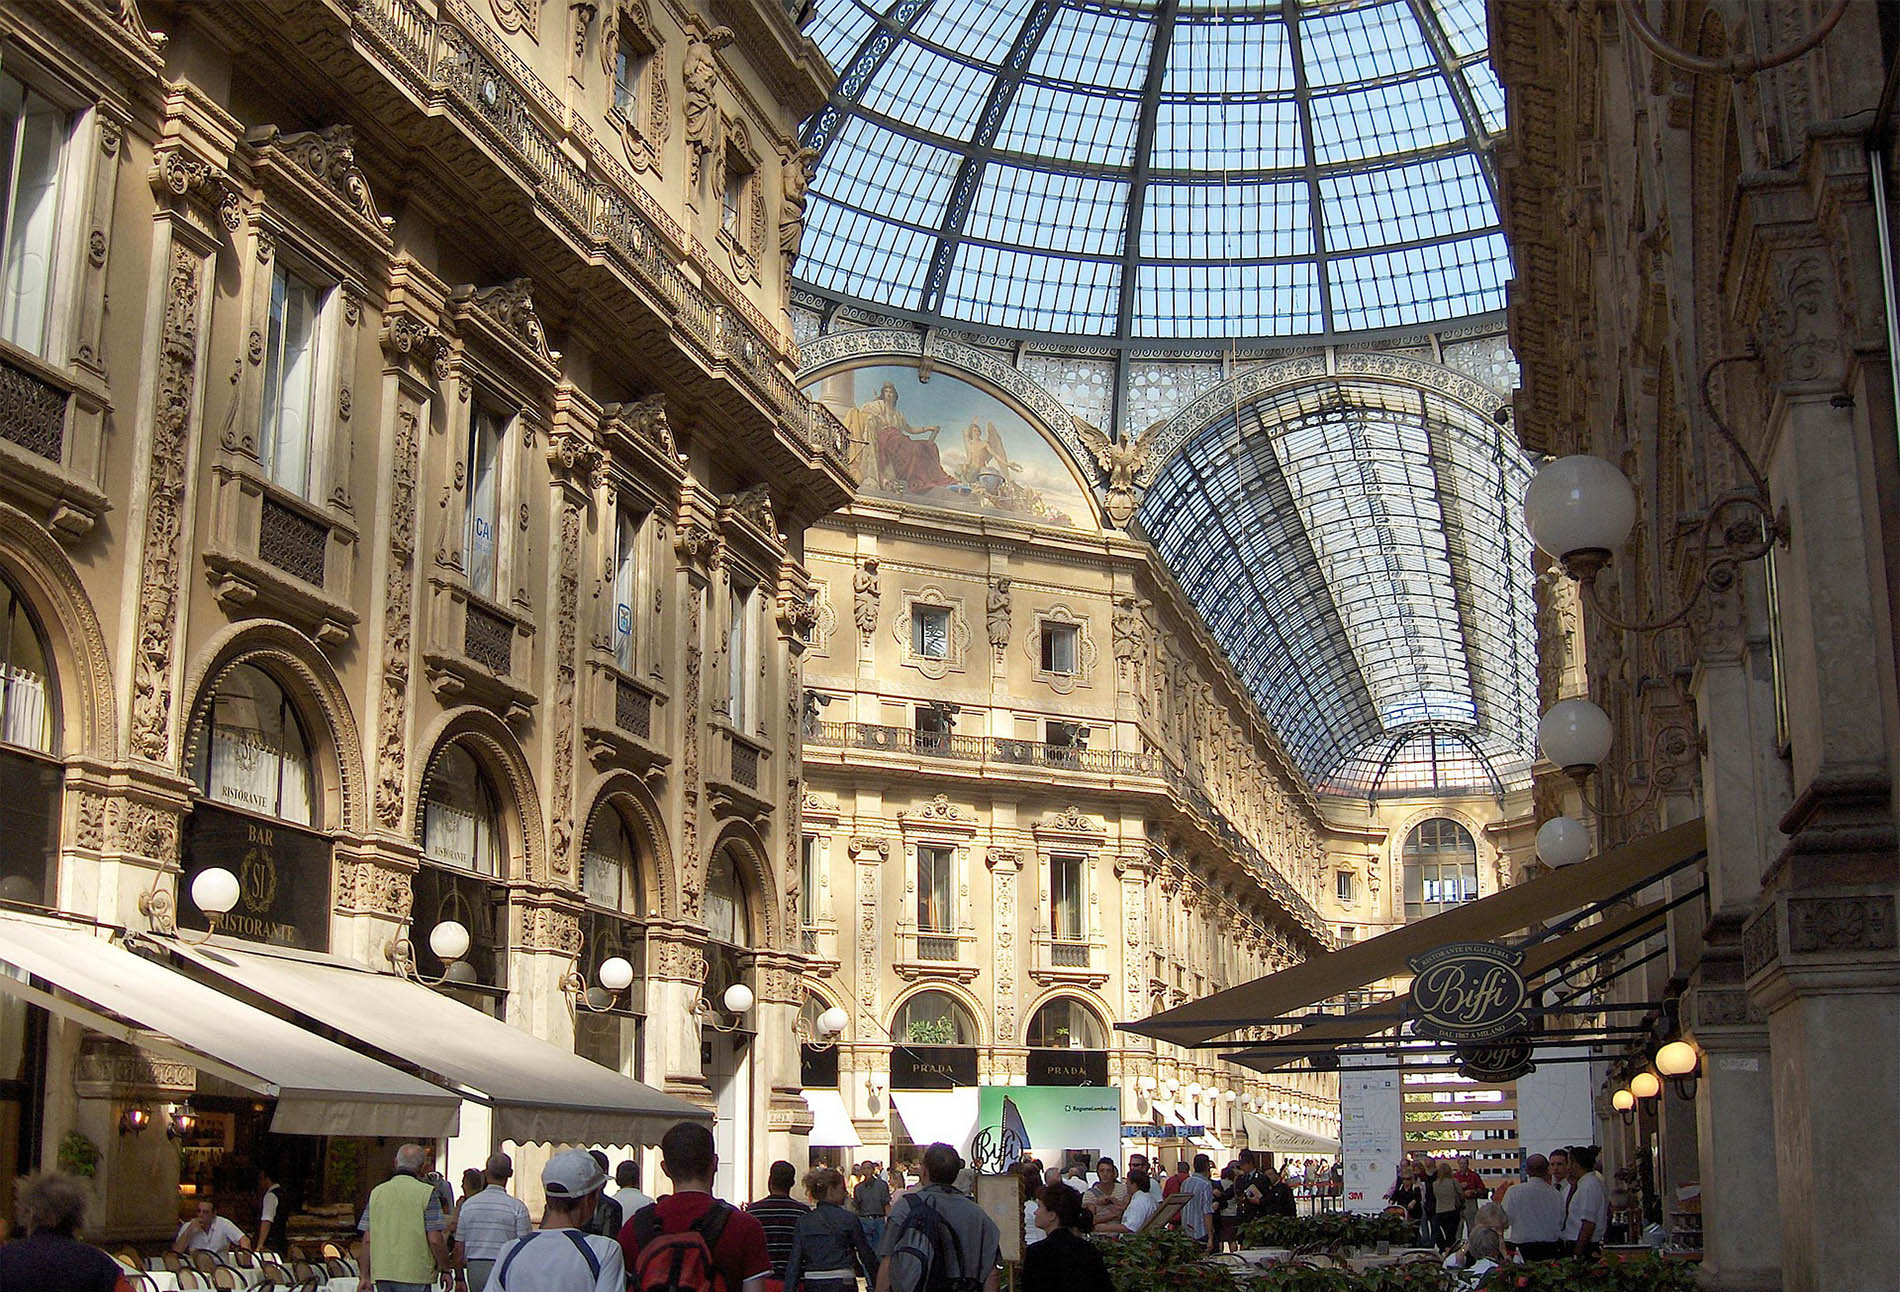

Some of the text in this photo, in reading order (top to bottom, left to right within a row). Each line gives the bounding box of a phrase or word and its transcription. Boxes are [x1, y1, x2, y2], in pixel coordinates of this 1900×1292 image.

[222, 786, 267, 808] RISTORANTE
[248, 824, 273, 846] BAR
[251, 863, 266, 899] SI
[216, 913, 295, 942] RISTORANTE
[1422, 946, 1464, 965] RISTORANTE
[1473, 946, 1509, 960] GALLERIA
[1427, 964, 1508, 1024] Biffi
[1438, 1029, 1454, 1038] DAL
[1476, 1025, 1506, 1038] MILANO
[912, 1064, 953, 1073] PRADA
[1047, 1066, 1086, 1075] PRADA
[1348, 1192, 1363, 1201] 3M
